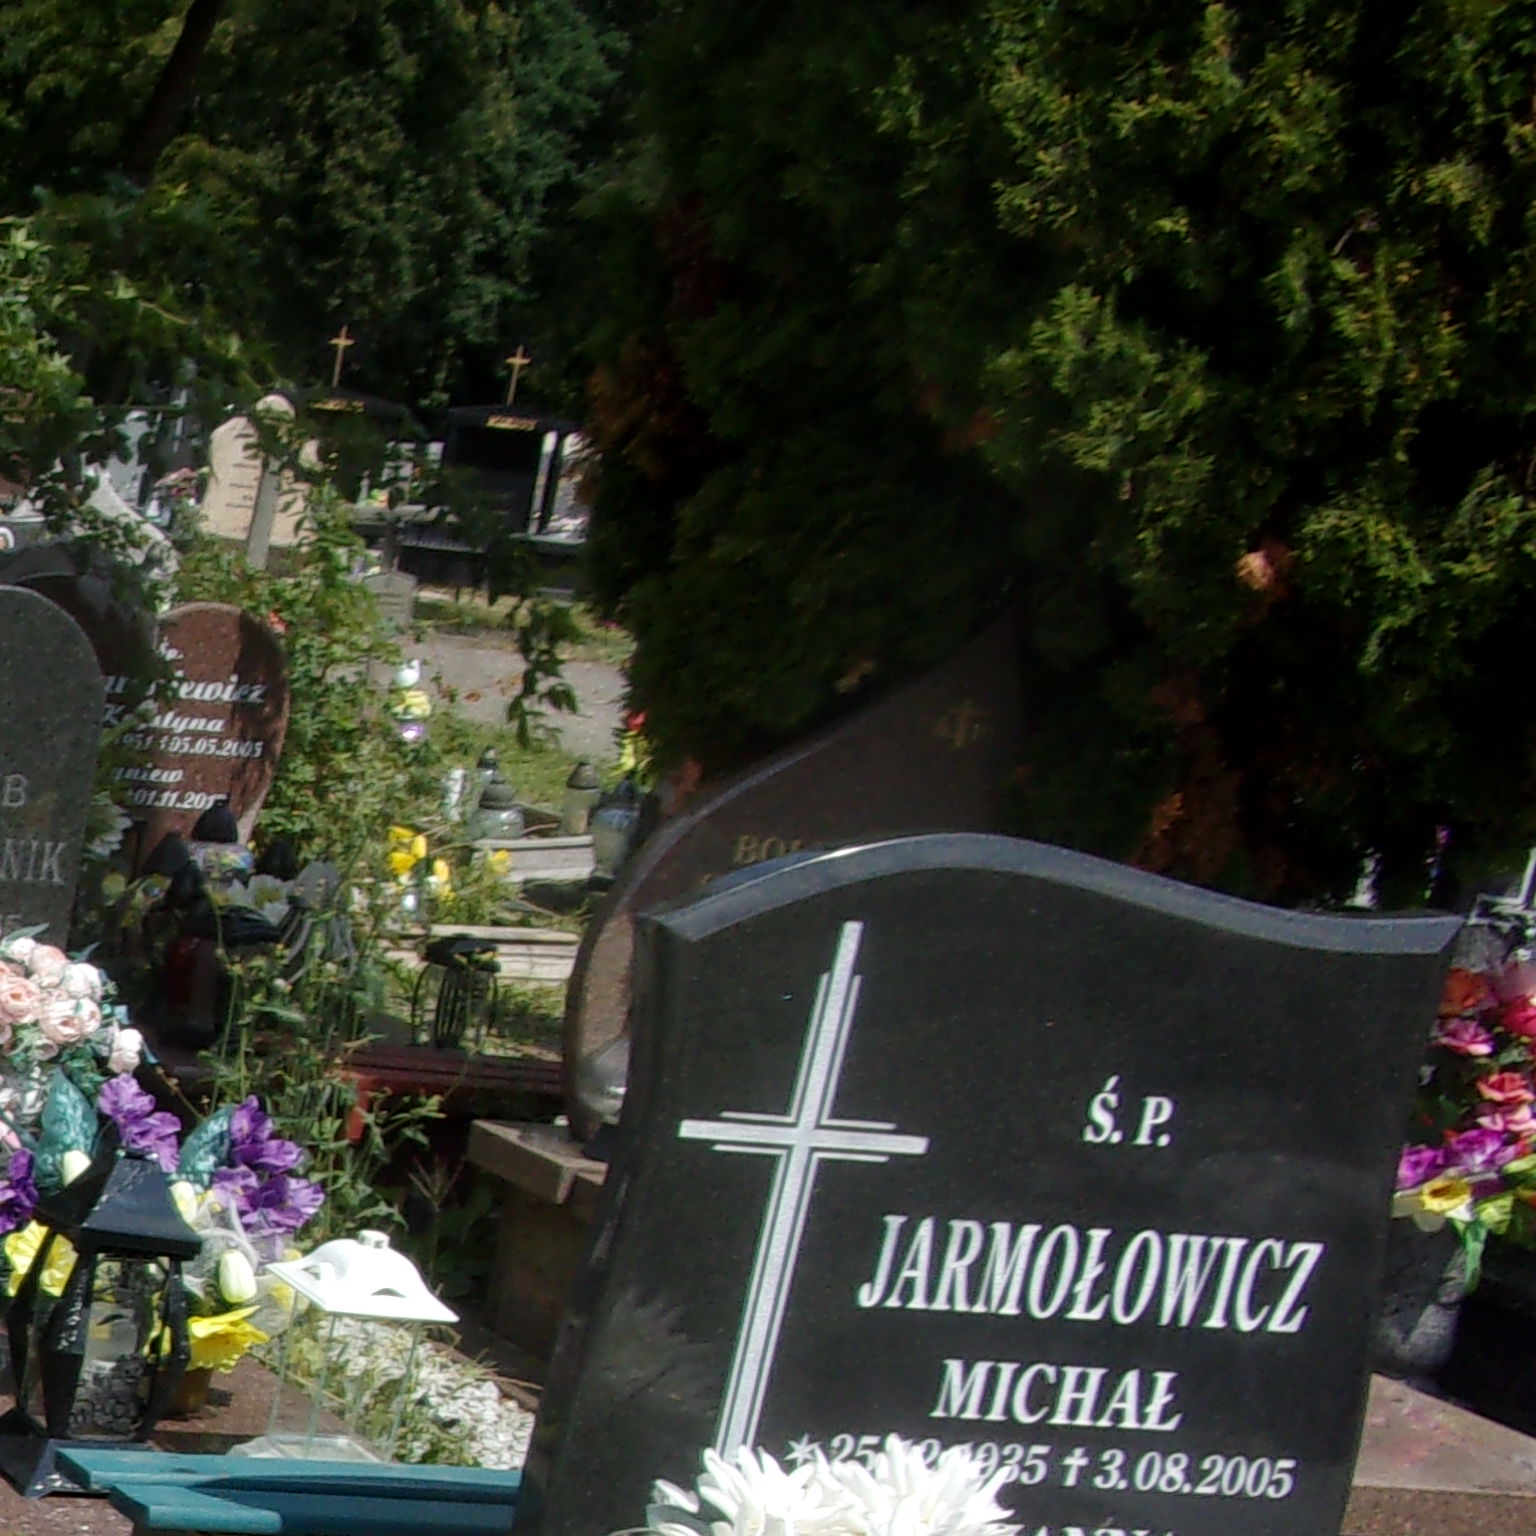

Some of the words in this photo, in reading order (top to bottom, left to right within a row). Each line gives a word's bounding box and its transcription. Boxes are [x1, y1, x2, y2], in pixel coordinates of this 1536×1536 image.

[858, 1214, 1324, 1334] JARMOŁOWICZ
[930, 1358, 1185, 1431] MICHAŁ
[1094, 1447, 1297, 1500] 3.08.2005
